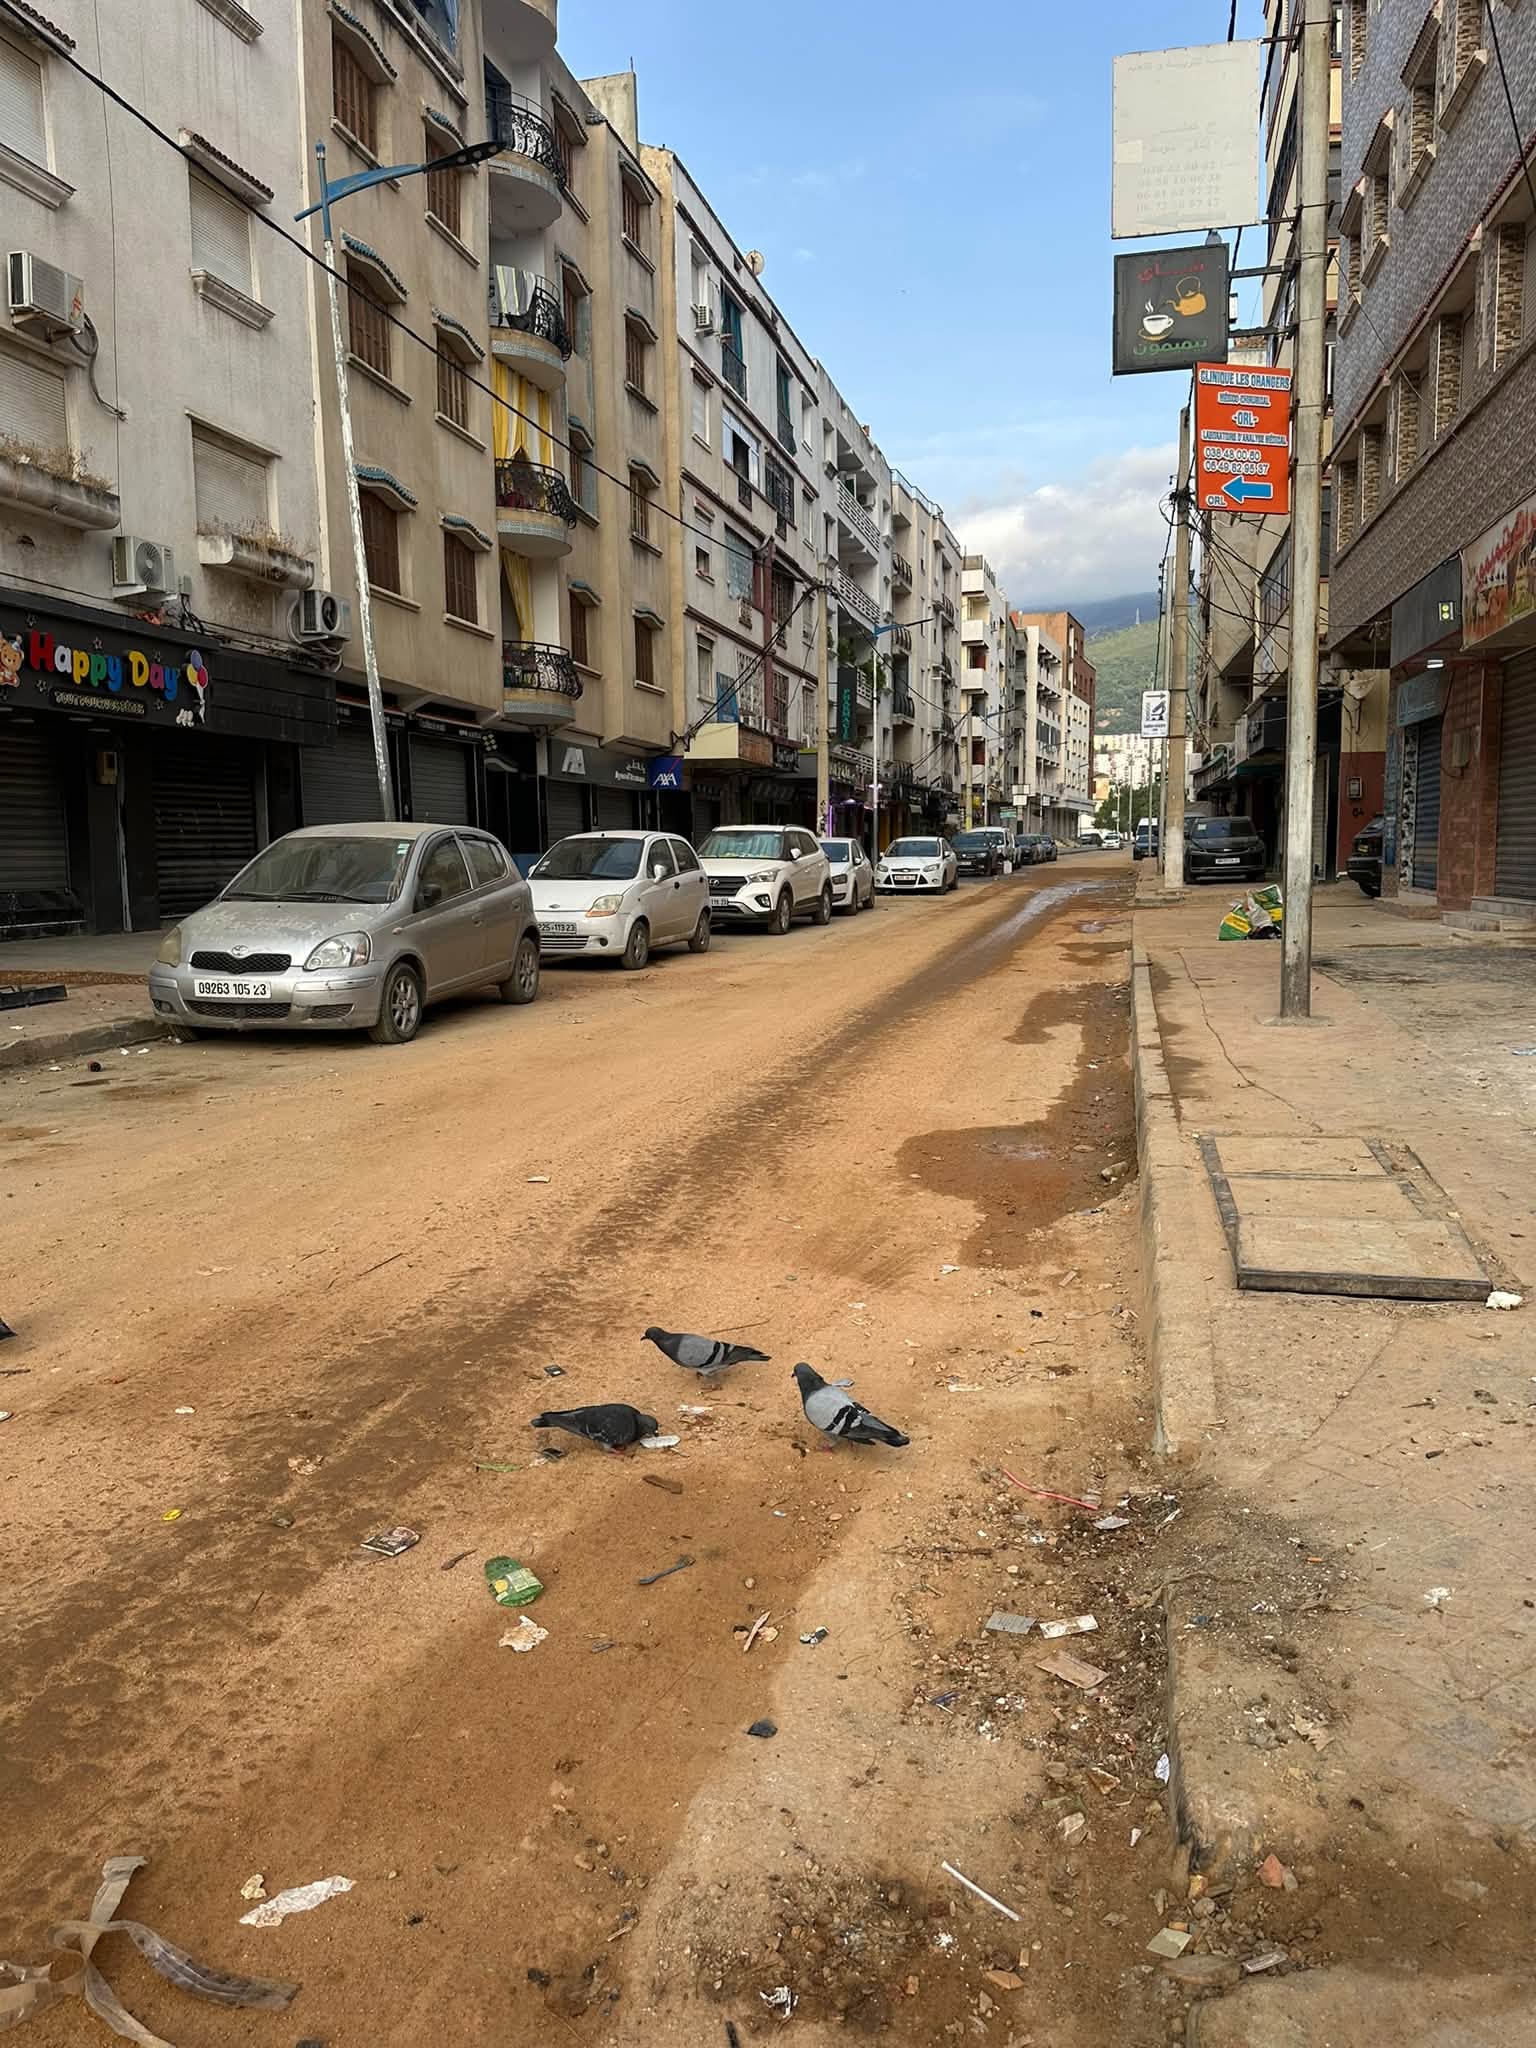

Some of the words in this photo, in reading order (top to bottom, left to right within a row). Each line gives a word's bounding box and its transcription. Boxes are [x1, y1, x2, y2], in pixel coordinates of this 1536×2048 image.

[1200, 370, 1235, 385] CLINIQUE
[1236, 373, 1250, 386] LES
[1250, 374, 1290, 389] ORANGERS
[1207, 496, 1226, 506] ORL
[30, 629, 123, 693] Happy
[129, 650, 178, 701] Day
[652, 773, 678, 786] AXA
[199, 981, 230, 995] 09263
[232, 983, 250, 996] 105
[253, 984, 267, 996] 23
